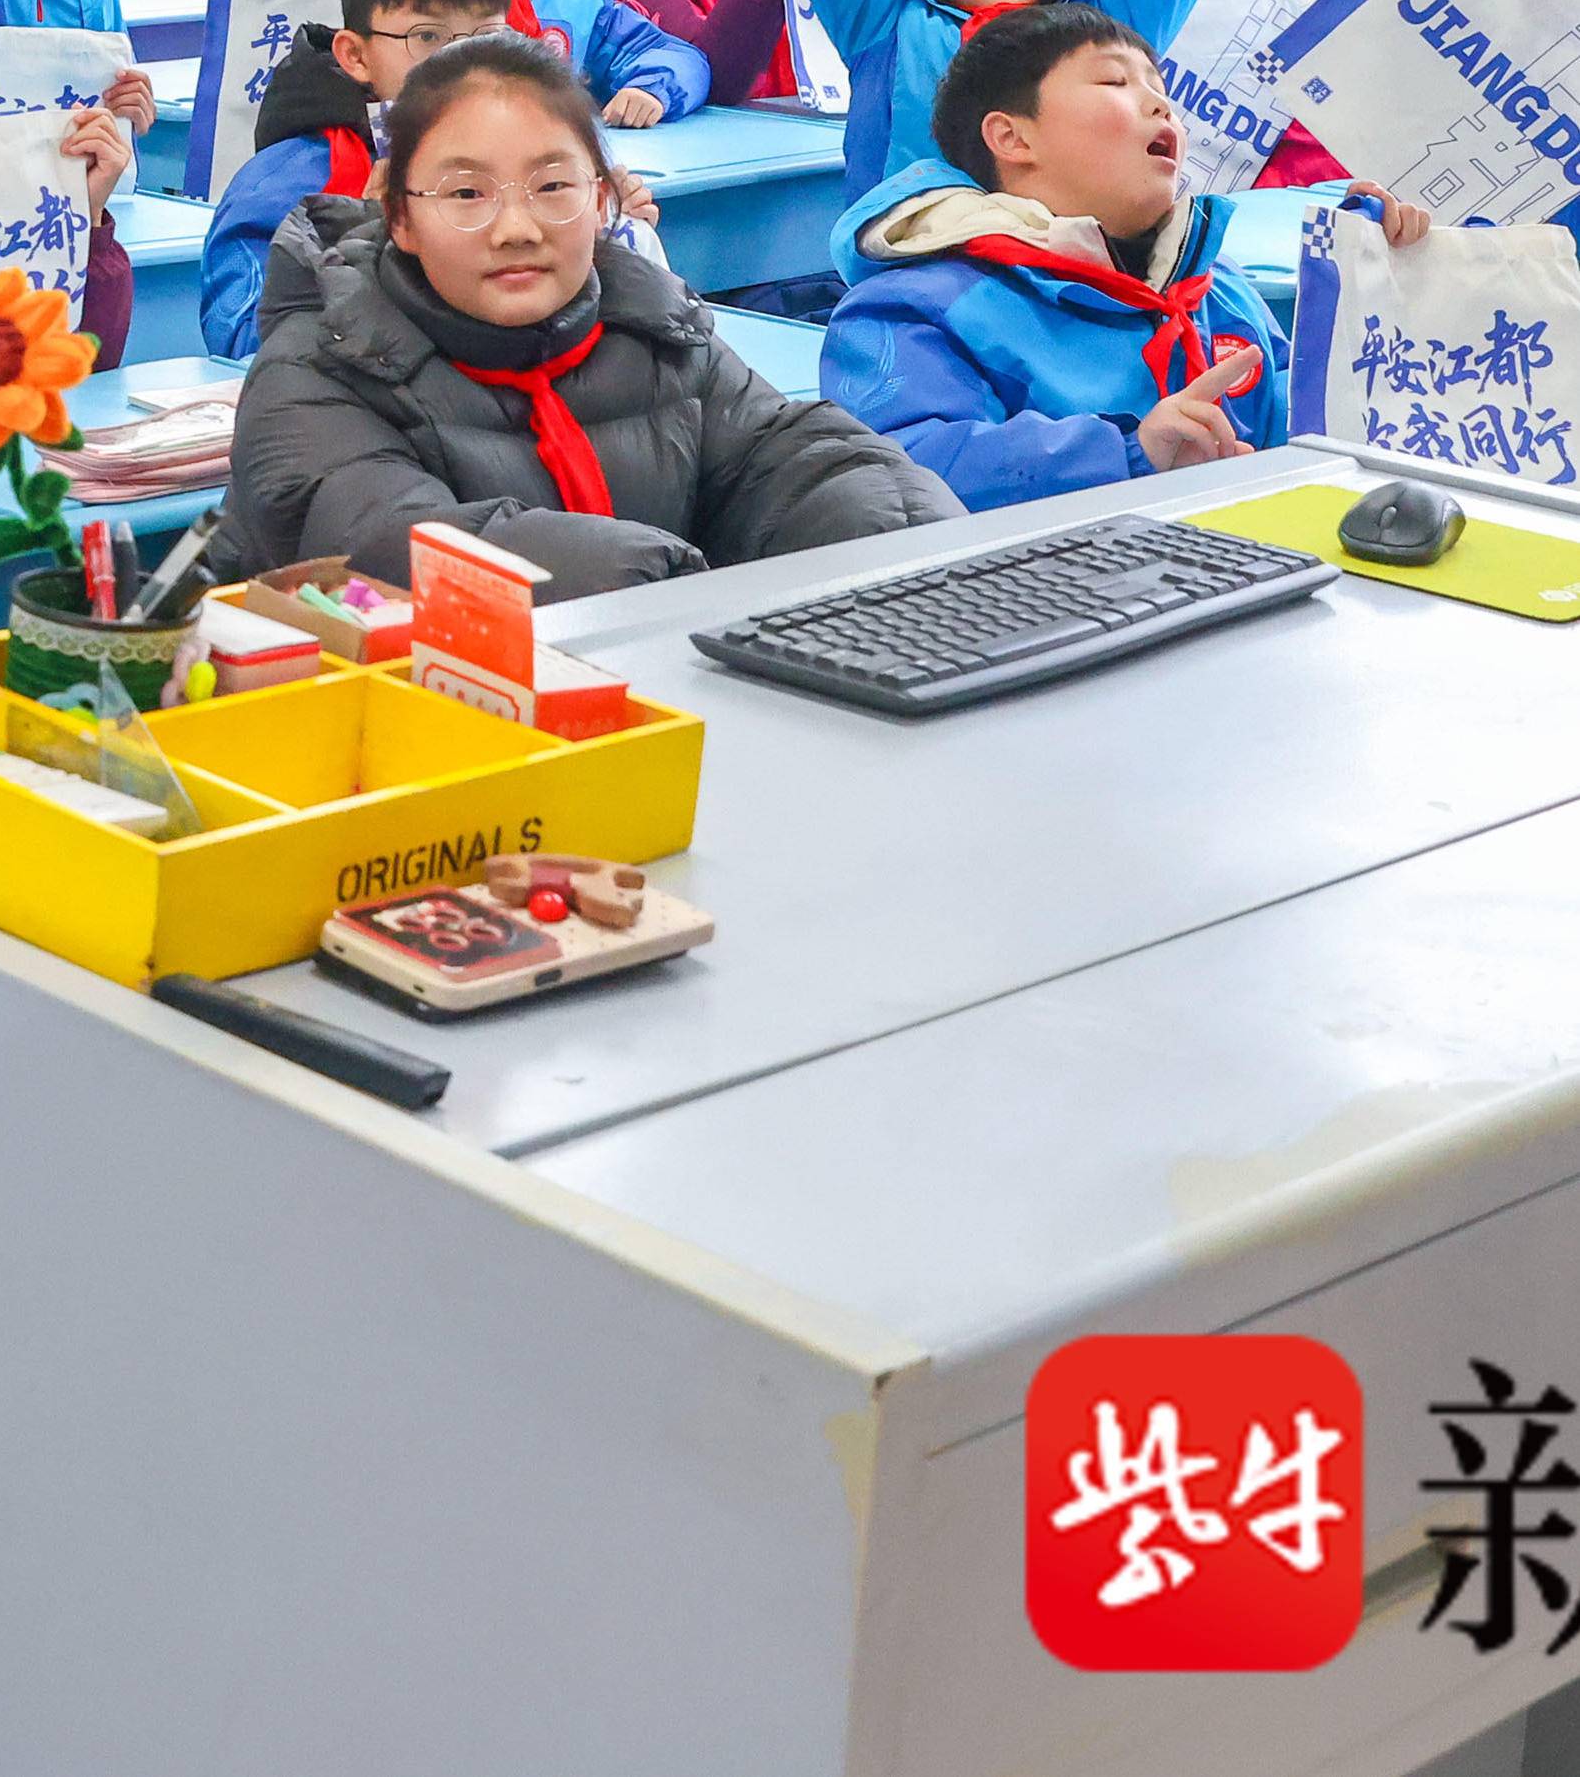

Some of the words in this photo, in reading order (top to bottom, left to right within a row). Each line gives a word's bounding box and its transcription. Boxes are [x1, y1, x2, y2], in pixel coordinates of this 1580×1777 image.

[1351, 309, 1554, 407] 平安江都
[335, 816, 544, 905] ORIGINALS
